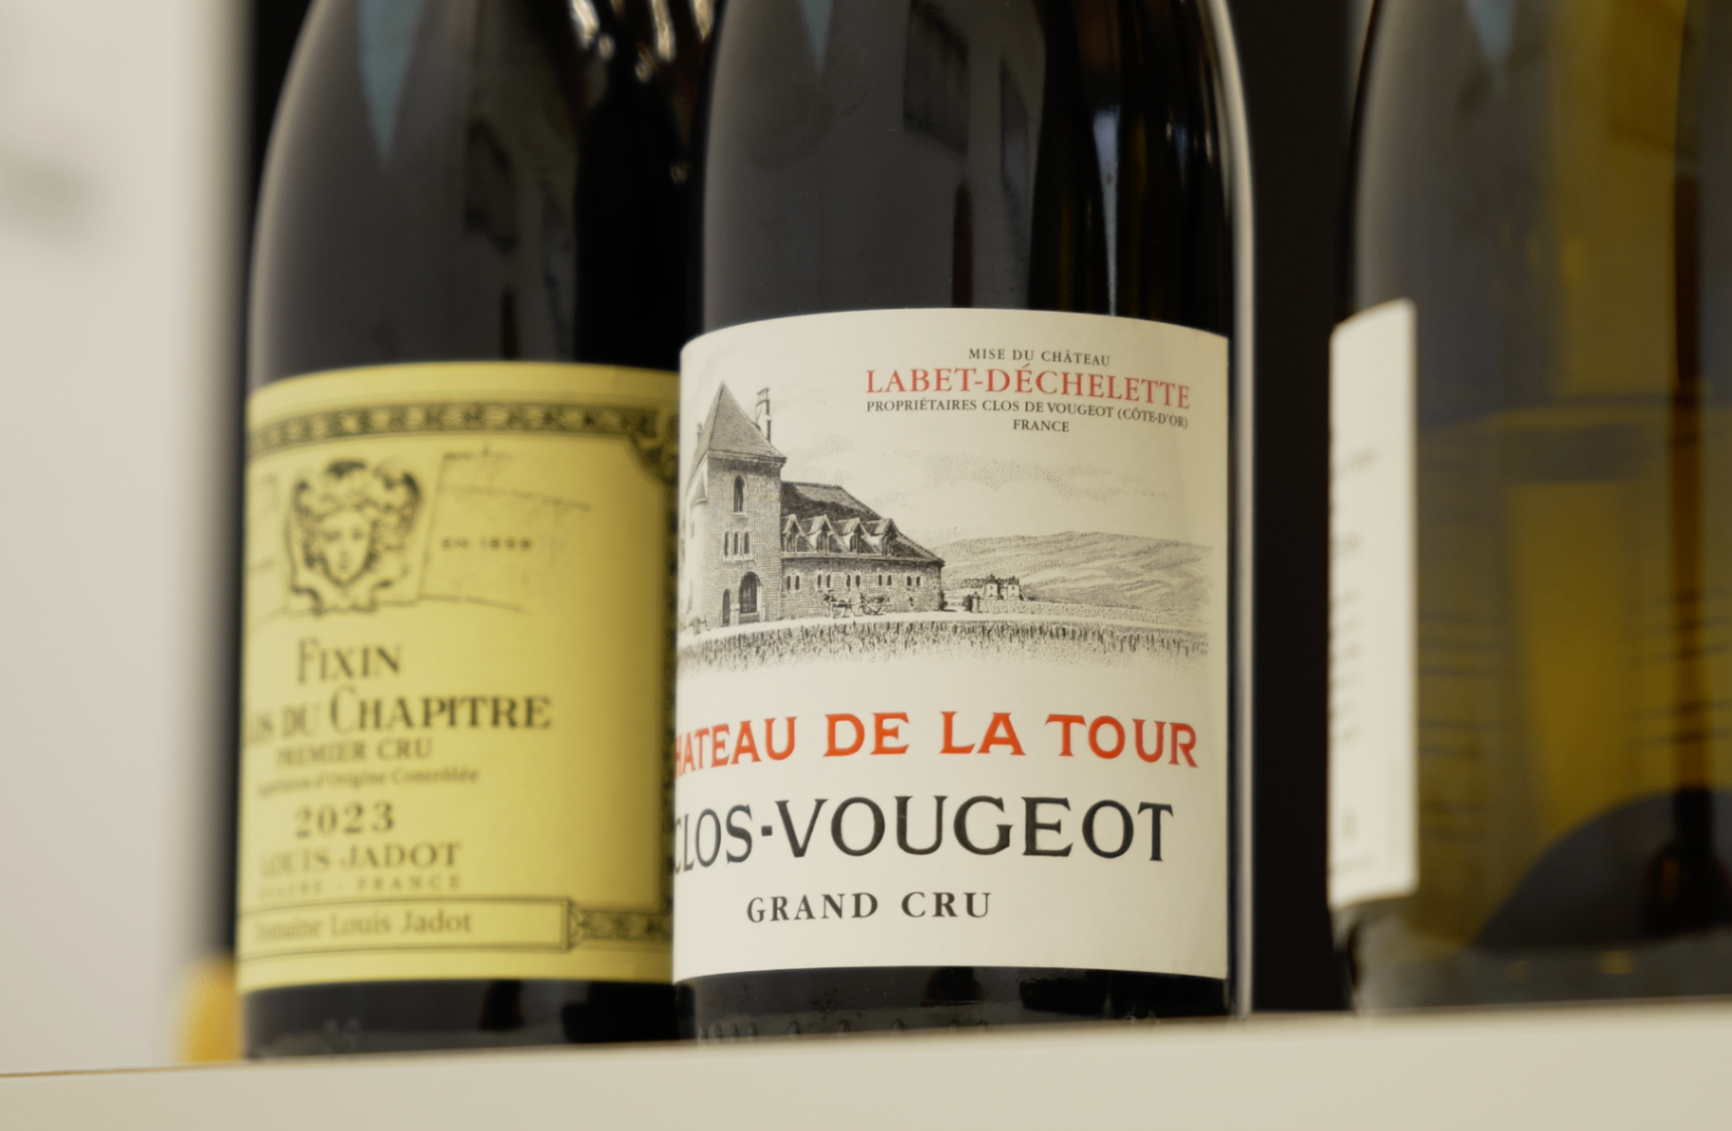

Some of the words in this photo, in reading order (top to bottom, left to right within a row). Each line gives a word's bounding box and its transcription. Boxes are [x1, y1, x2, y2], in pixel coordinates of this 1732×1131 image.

[968, 348, 1005, 360] MISE
[1012, 350, 1034, 361] DU
[1041, 349, 1111, 367] CHÂTEAU
[866, 363, 1190, 409] LABET-DÉCHELETTE
[866, 398, 977, 412] PROPRIÉTAIRES
[981, 400, 1020, 412] CLOS
[1024, 401, 1044, 413] DE
[1047, 402, 1114, 418] VOUGEOT
[1117, 406, 1188, 429] (CÔTE-D'OR)
[1013, 419, 1070, 433] FRANCE
[297, 638, 403, 685] FIXIN
[281, 702, 321, 740] DU
[330, 685, 552, 736] CHAPITRE
[375, 737, 434, 761] CRU
[675, 717, 798, 778] HATEAU
[823, 712, 909, 757] DE
[939, 711, 1026, 755] LA
[1044, 714, 1198, 768] TOUR
[294, 802, 396, 839] 2023
[341, 842, 461, 870] JADOT
[401, 907, 472, 934] Jadot
[747, 892, 879, 923] GRAND
[900, 892, 992, 918] CRU
